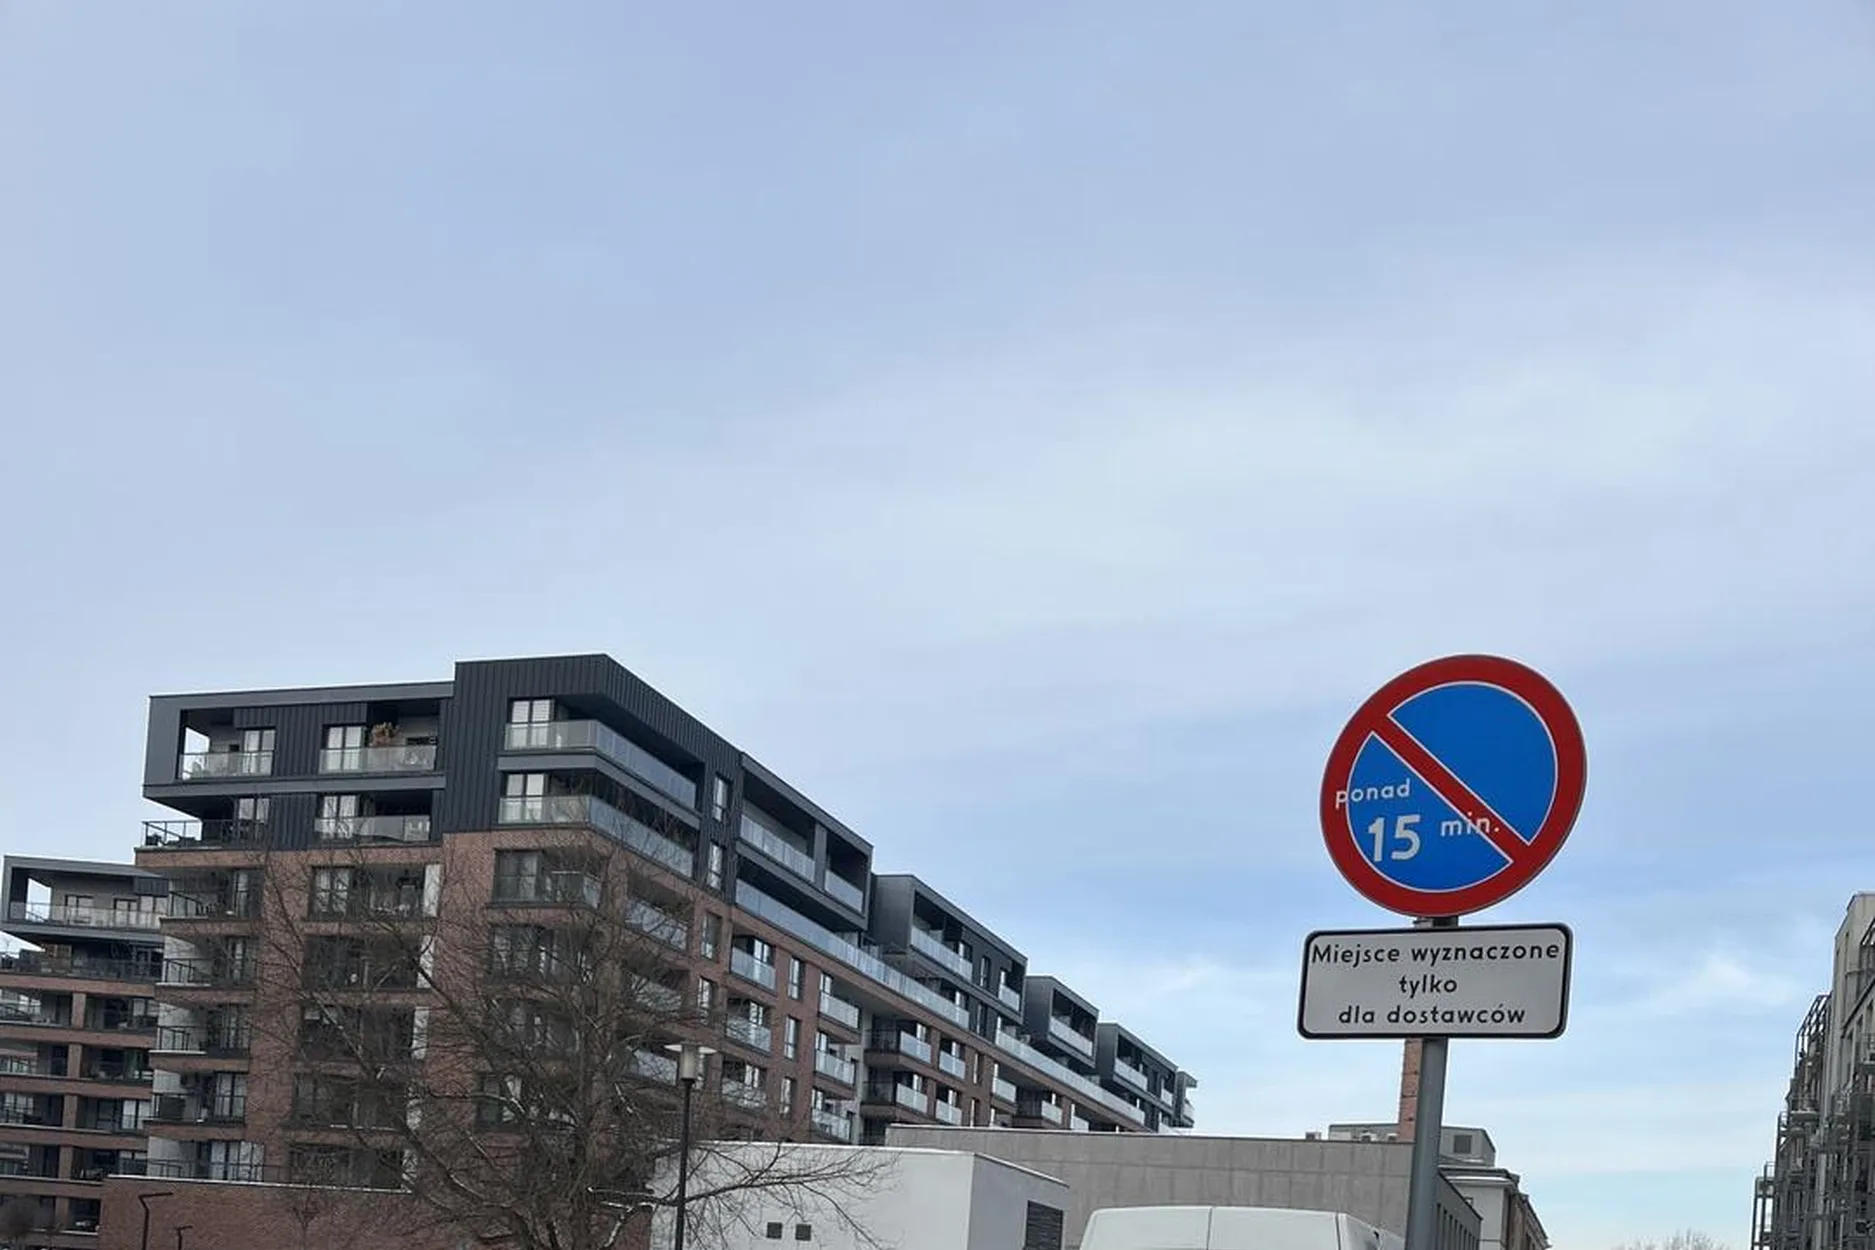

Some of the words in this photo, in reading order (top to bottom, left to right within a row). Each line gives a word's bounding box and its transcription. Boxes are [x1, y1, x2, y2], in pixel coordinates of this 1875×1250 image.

[1335, 777, 1411, 810] ponad
[1367, 814, 1421, 862] 15
[1441, 811, 1500, 837] min.
[1312, 944, 1401, 968] Miejsce
[1411, 945, 1560, 967] wyznaczone
[1399, 974, 1458, 999] tylko
[1338, 1005, 1376, 1024] dla
[1386, 1003, 1526, 1025] dostawców
